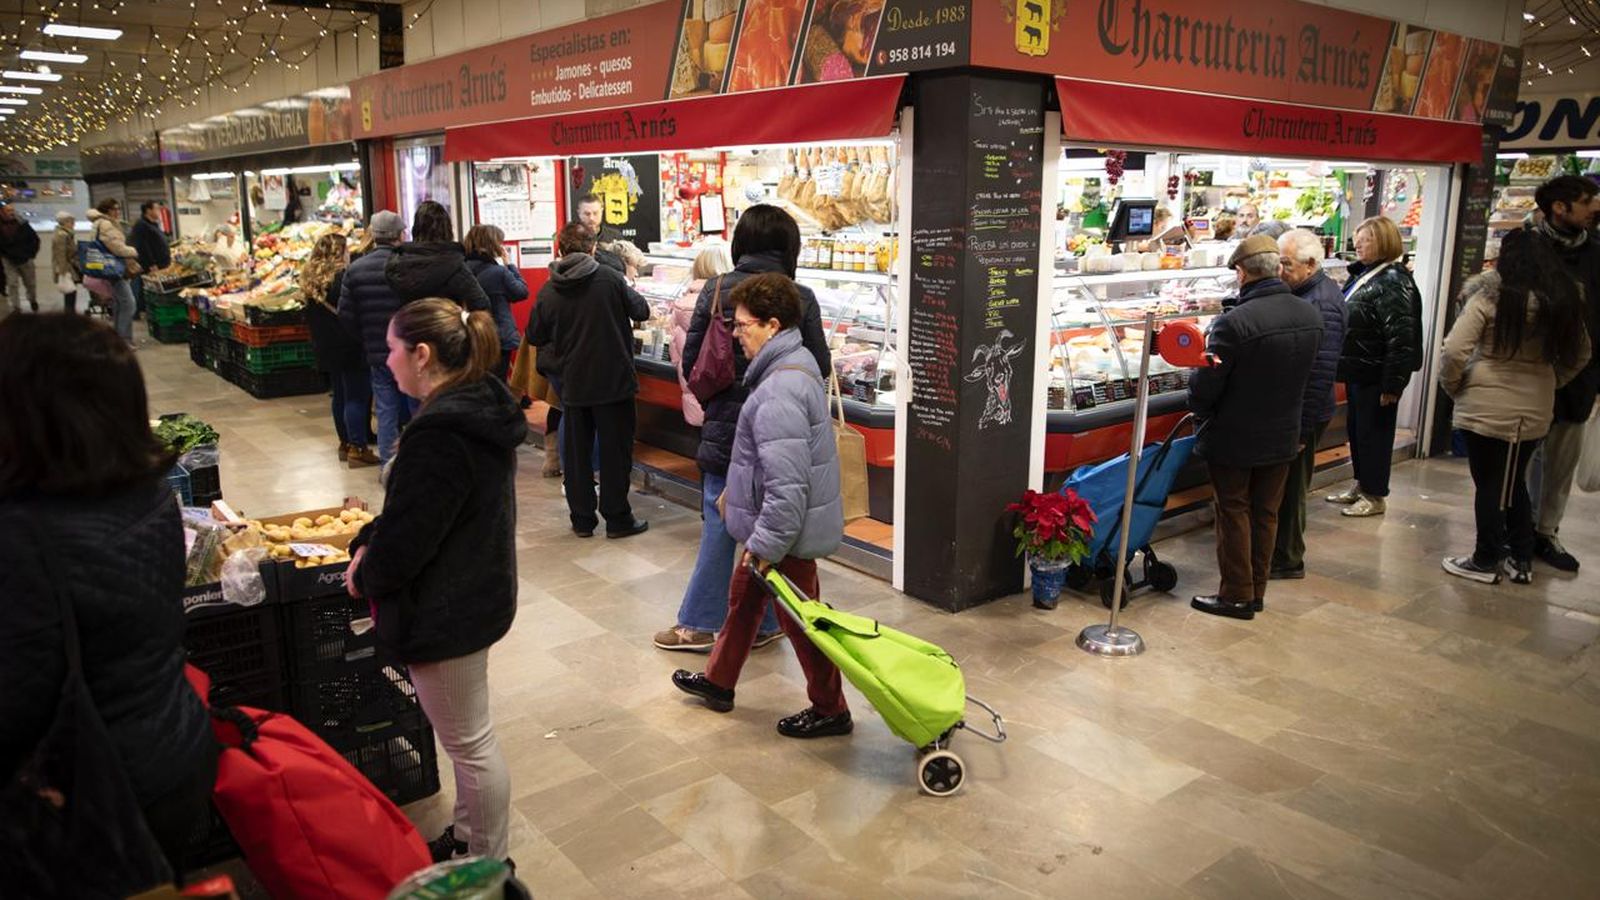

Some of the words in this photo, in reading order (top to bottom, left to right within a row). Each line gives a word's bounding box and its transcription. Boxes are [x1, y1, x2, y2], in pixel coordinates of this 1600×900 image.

[887, 6, 932, 31] Desde
[936, 5, 966, 24] 1983
[530, 32, 606, 66] Especialistas
[609, 27, 632, 47] en:
[889, 47, 909, 63] 958
[911, 44, 932, 60] 814
[935, 41, 956, 57] 194
[1297, 23, 1371, 91] Arnés
[459, 55, 507, 108] Arnés
[555, 62, 592, 81] Jamones
[599, 55, 632, 78] quesos
[531, 85, 572, 106] Embutidos
[578, 80, 633, 100] Delicatessen
[215, 114, 266, 147] VERDURAS
[270, 110, 305, 140] NURIA
[622, 108, 676, 141] Arnés
[1329, 112, 1377, 147] Arnés
